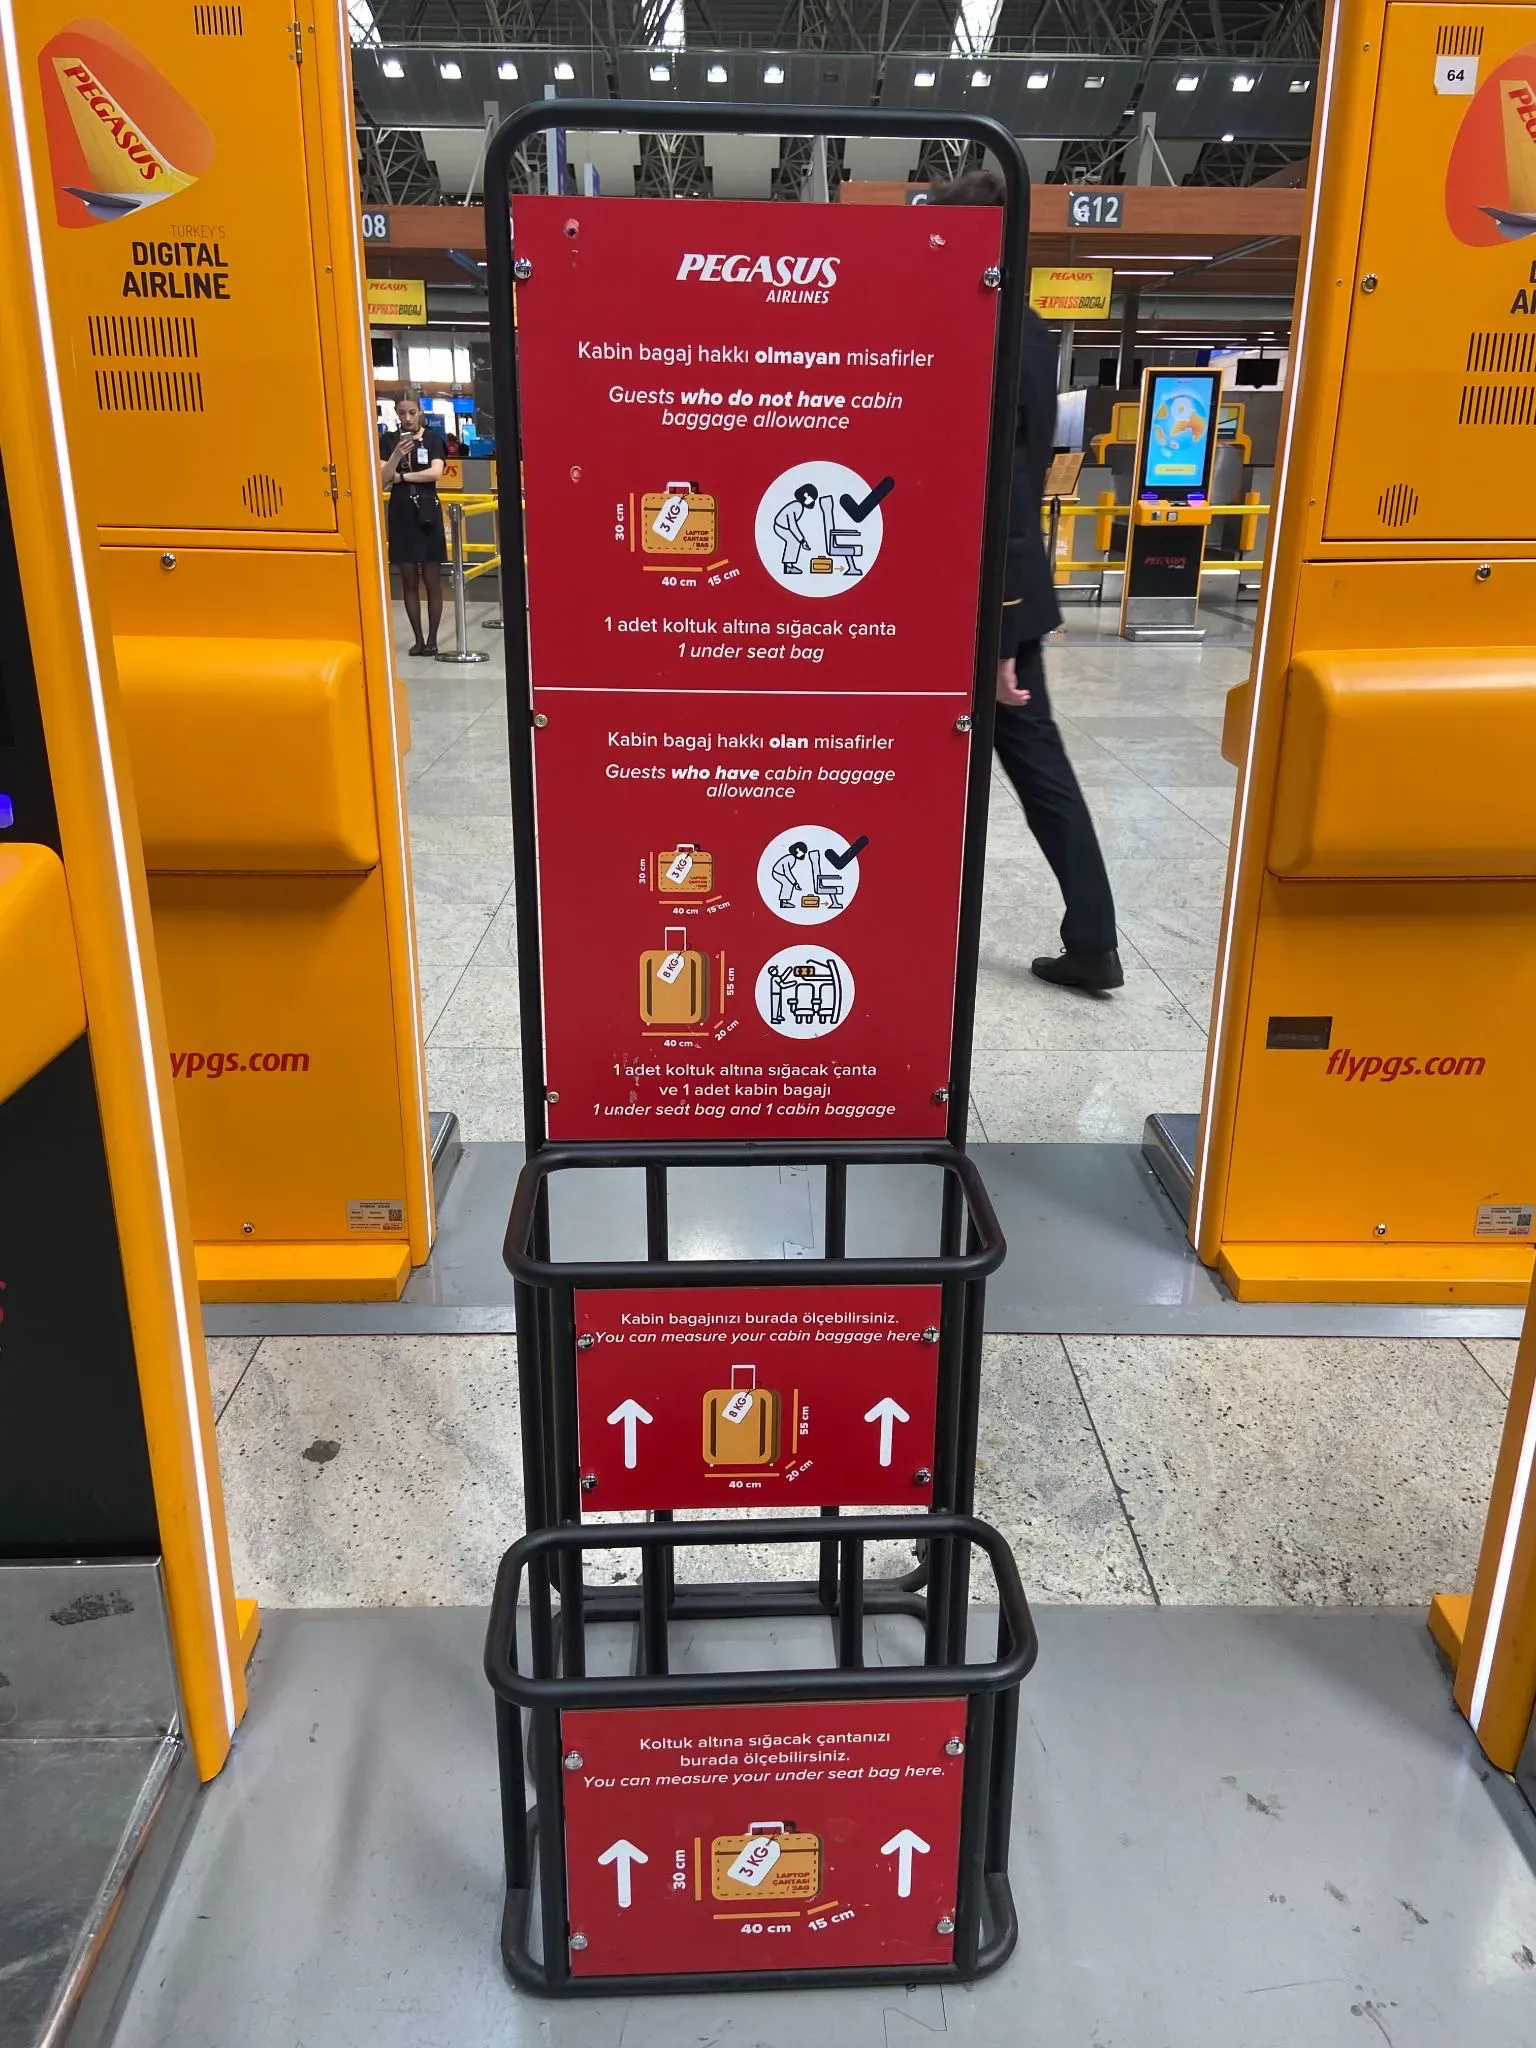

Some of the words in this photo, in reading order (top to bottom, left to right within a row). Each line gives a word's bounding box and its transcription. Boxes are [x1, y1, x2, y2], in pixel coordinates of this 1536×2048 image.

[1447, 69, 1465, 82] 64
[63, 65, 163, 180] PEGASUS
[1073, 196, 1119, 223] G12
[170, 224, 226, 239] TURKEY'S
[362, 213, 387, 238] 08
[132, 241, 229, 267] DIGITAL
[675, 253, 841, 289] PEGASUS
[1049, 272, 1094, 282] PEGASUS
[122, 271, 231, 300] AIRLINE
[369, 283, 408, 291] PEGASUS
[765, 289, 830, 305] AIRLINES
[578, 341, 633, 360] Kabin
[639, 342, 692, 367] bagaj
[698, 344, 749, 363] hakkı
[754, 346, 841, 369] olmayan
[846, 348, 935, 367] misafirler
[608, 385, 675, 405] Guests
[680, 387, 724, 406] who
[727, 388, 754, 407] do
[758, 391, 794, 408] not
[796, 390, 846, 409] have
[850, 391, 903, 409] cabin
[661, 408, 748, 432] baggage
[753, 410, 850, 430] allowance
[617, 503, 624, 522] cm
[660, 522, 671, 533] 3
[668, 504, 681, 523] KG
[615, 524, 624, 540] 30
[662, 577, 677, 587] 40
[680, 578, 696, 587] cm
[708, 575, 721, 587] 15
[722, 567, 740, 579] cm
[604, 616, 612, 632] 1
[617, 616, 658, 633] adet
[663, 617, 718, 634] koltuk
[722, 618, 771, 635] altına
[776, 619, 843, 639] sığacak
[848, 621, 896, 639] çanta
[678, 642, 686, 658] 1
[690, 643, 743, 659] under
[746, 644, 786, 659] seat
[789, 644, 825, 664] bag
[608, 731, 658, 747] Kabin
[663, 732, 712, 752] bagaj
[717, 733, 764, 749] hakkı
[768, 733, 809, 749] olan
[814, 734, 895, 750] misafirler
[605, 763, 666, 780] Guests
[671, 764, 711, 780] who
[714, 765, 760, 781] have
[764, 766, 813, 781] cabin
[817, 766, 896, 785] baggage
[706, 783, 796, 798] allowance
[640, 859, 646, 871] cm
[676, 859, 687, 872] KG
[639, 873, 646, 884] 30
[706, 905, 717, 914] 15
[717, 901, 730, 909] cm
[667, 958, 678, 971] KG
[728, 968, 734, 981] cm
[727, 984, 734, 995] 55
[715, 1030, 726, 1041] 20
[727, 1020, 739, 1031] cm
[170, 1052, 310, 1078] ypgs.com
[613, 1064, 620, 1076] 1
[625, 1063, 662, 1076] adet
[665, 1063, 715, 1076] koltuk
[720, 1064, 763, 1077] altına
[768, 1063, 828, 1080] sığacak
[833, 1065, 877, 1080] çanta
[1326, 1049, 1486, 1082] flypgs.com
[659, 1086, 678, 1096] ve
[683, 1084, 689, 1096] 1
[694, 1083, 730, 1096] adet
[735, 1083, 778, 1096] kabin
[783, 1084, 831, 1101] bagajı
[593, 1104, 600, 1116] 1
[604, 1103, 652, 1116] under
[655, 1103, 691, 1116] seat
[694, 1103, 726, 1119] bag
[729, 1103, 762, 1116] and
[766, 1104, 773, 1116] 1
[776, 1102, 820, 1116] cabin
[824, 1102, 896, 1118] baggage
[621, 1313, 664, 1325] Kabin
[669, 1312, 741, 1327] bagajınızı
[745, 1312, 798, 1324] burada
[802, 1311, 899, 1326] ölçebilirsiniz.
[596, 1331, 624, 1343] You
[628, 1333, 657, 1343] can
[660, 1332, 728, 1342] measure
[730, 1332, 766, 1345] your
[769, 1329, 811, 1342] cabin
[814, 1329, 883, 1344] baggage
[887, 1330, 923, 1342] here.
[734, 1397, 746, 1411] KG
[802, 1406, 809, 1420] cm
[800, 1422, 808, 1435] 55
[786, 1470, 799, 1481] 20
[800, 1460, 813, 1472] cm
[640, 1737, 693, 1750] Koltuk
[698, 1736, 743, 1748] altına
[748, 1733, 812, 1749] sığacak
[816, 1732, 890, 1747] çantanızı
[680, 1753, 738, 1767] burada
[743, 1749, 850, 1767] ölçebilirsiniz.
[583, 1776, 616, 1788] You
[620, 1776, 651, 1787] can
[655, 1774, 729, 1786] measure
[732, 1772, 772, 1786] your
[775, 1768, 825, 1781] under
[827, 1767, 865, 1780] seat
[867, 1766, 901, 1780] bag
[904, 1765, 945, 1777] here.
[675, 1849, 685, 1869] cm
[739, 1867, 753, 1877] 3
[747, 1846, 769, 1867] KG
[673, 1872, 685, 1889] 30
[740, 1923, 763, 1934] 40
[767, 1923, 791, 1933] cm
[807, 1920, 828, 1931] 15
[831, 1909, 855, 1923] cm
